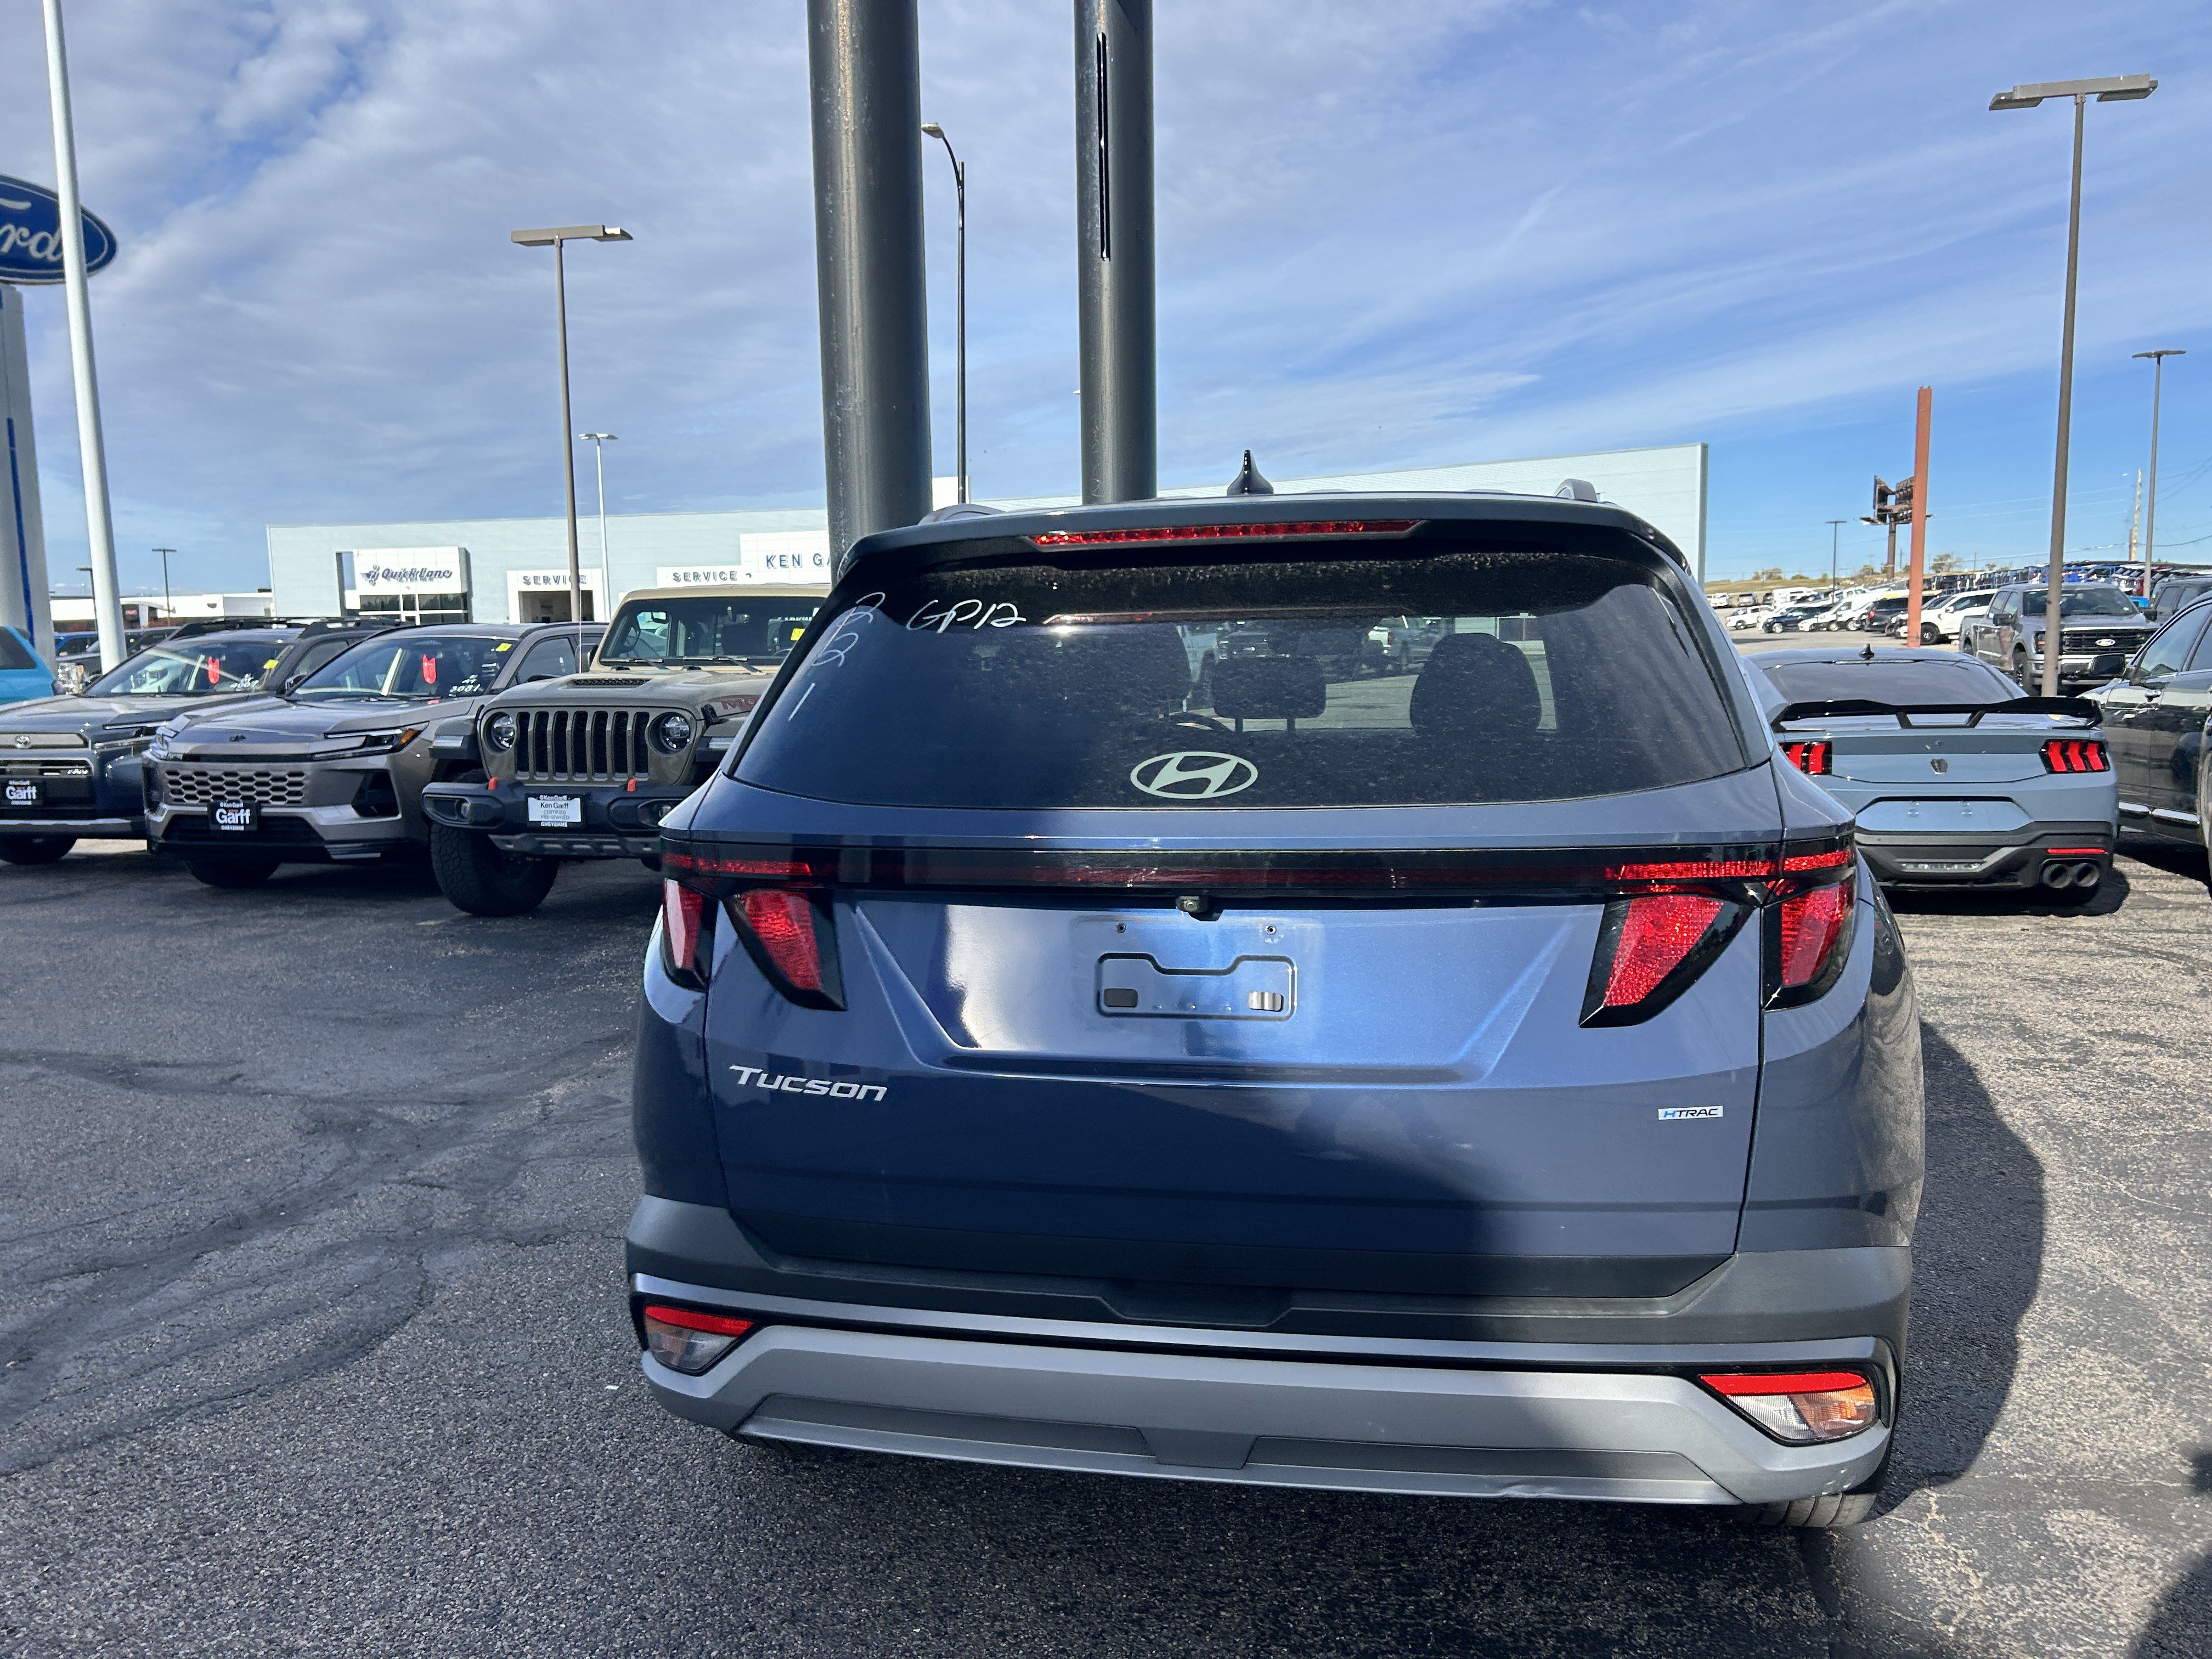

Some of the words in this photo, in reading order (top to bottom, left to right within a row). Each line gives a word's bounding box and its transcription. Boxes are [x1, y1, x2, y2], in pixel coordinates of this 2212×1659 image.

[766, 554, 803, 568] KEN
[523, 575, 586, 585] SERVIE
[673, 571, 737, 583] SERVICE
[5, 786, 37, 800] Garff
[216, 808, 250, 824] Garff
[1663, 1108, 1719, 1118] HTRAC
